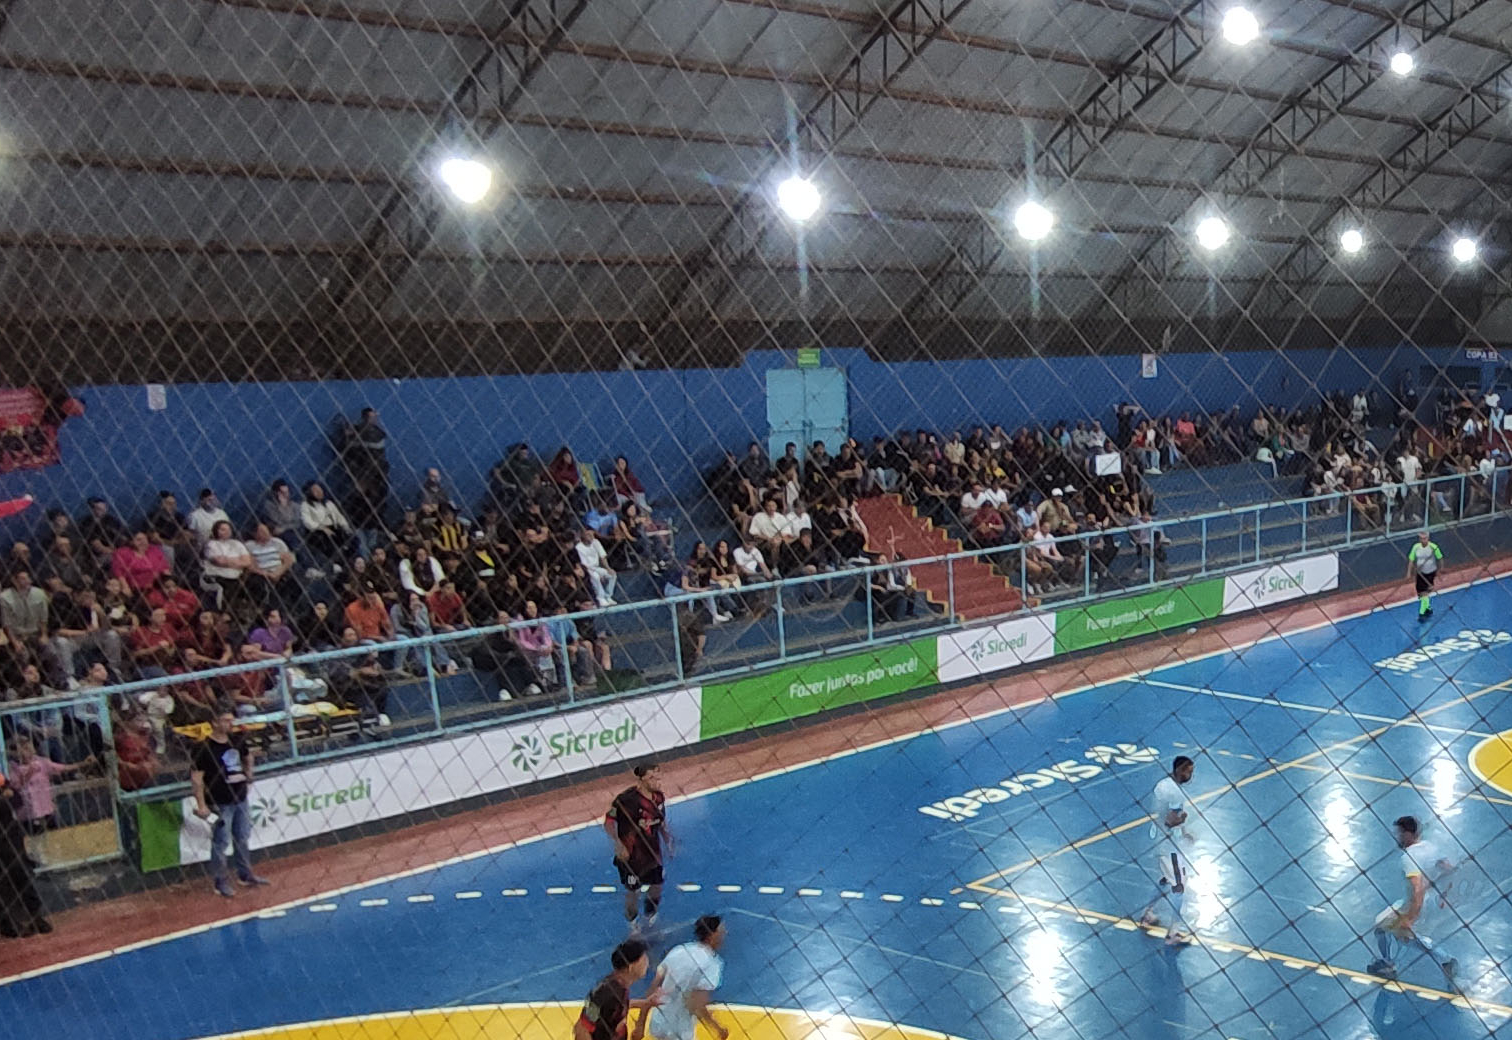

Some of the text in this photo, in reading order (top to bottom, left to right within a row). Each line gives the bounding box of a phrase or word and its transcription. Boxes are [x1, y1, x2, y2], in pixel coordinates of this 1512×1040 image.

[1268, 570, 1305, 593] Sicredi
[986, 632, 1028, 656] Sicredi
[789, 657, 919, 699] Fazer juntos por você!
[549, 716, 638, 760] Sicredi
[284, 778, 373, 818] Sicredi
[918, 760, 1102, 822] Sicredi
